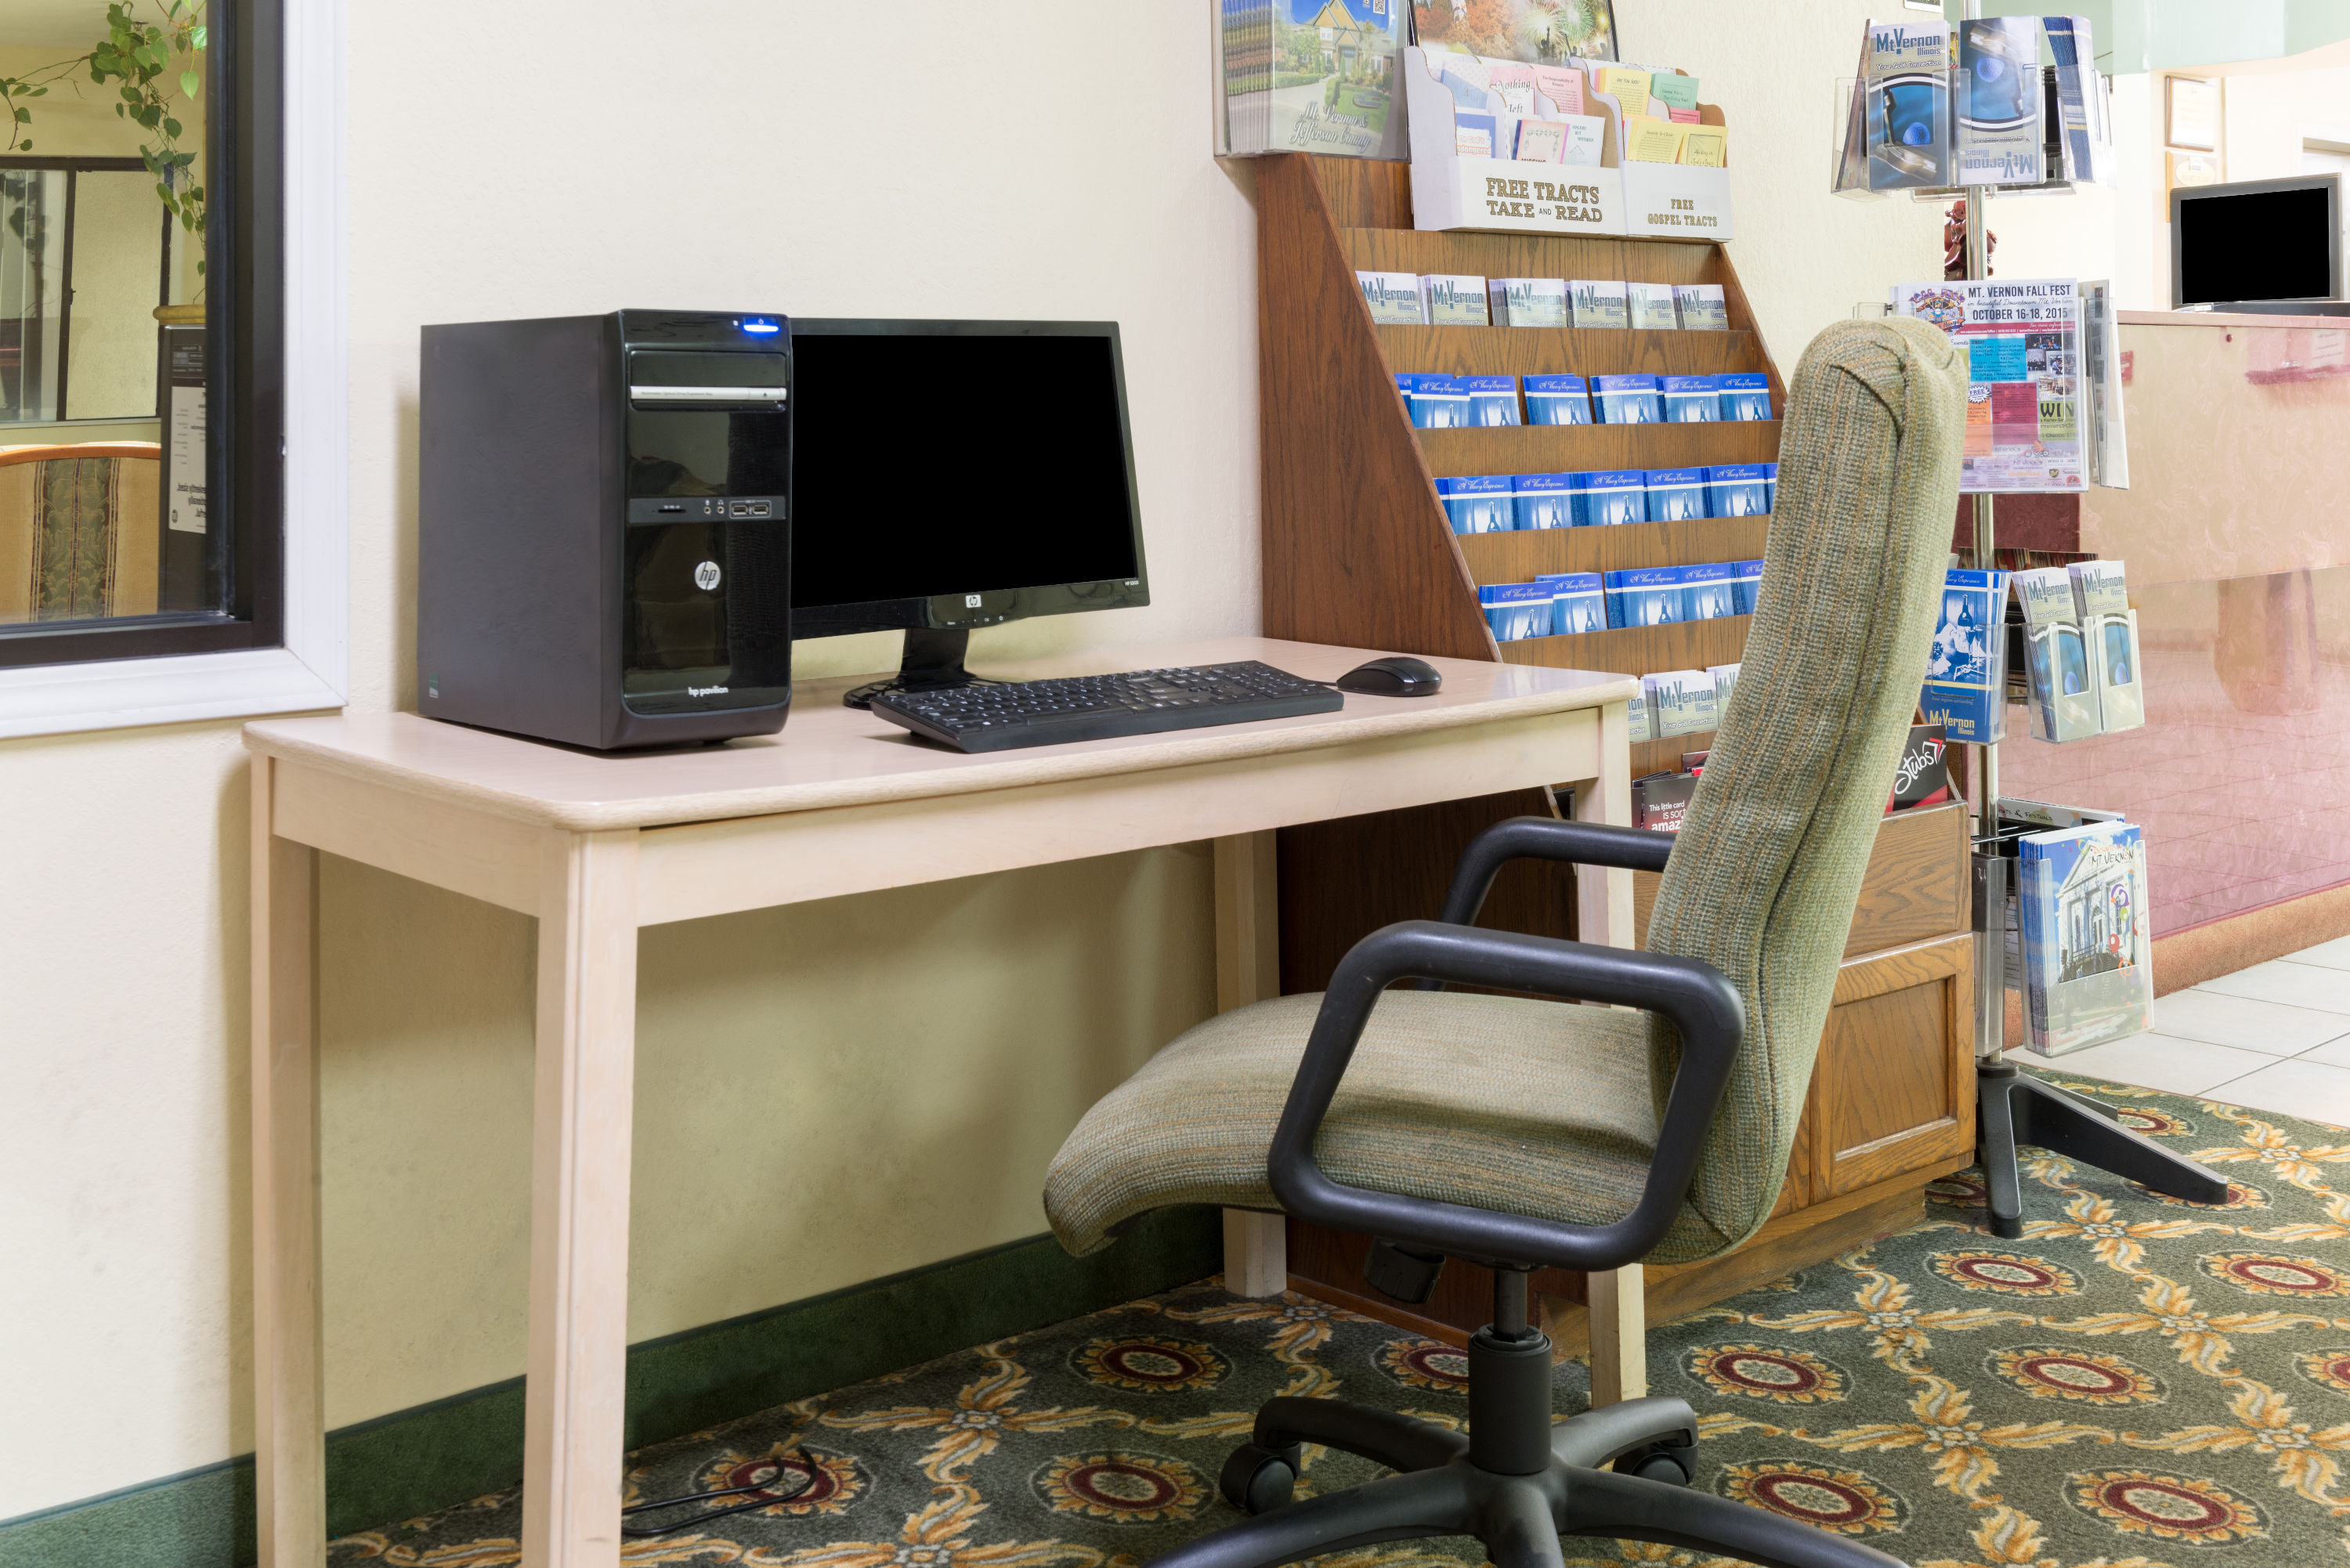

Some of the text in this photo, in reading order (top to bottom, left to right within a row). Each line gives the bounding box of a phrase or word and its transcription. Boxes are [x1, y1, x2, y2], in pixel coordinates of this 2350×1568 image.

[1496, 79, 1531, 92] Nothing
[1299, 100, 1368, 128] Mt. Vernon &
[1289, 120, 1371, 154] Jefferson County
[1486, 177, 1600, 204] FREE TRACTS
[1486, 200, 1535, 218] TAKE
[1555, 205, 1603, 222] READ
[1671, 198, 1694, 211] FREE
[1647, 213, 1718, 227] GOSPEL TRACTS
[1969, 284, 2071, 298] MT. VERNON FALL FEST
[1976, 299, 2001, 309] beautiful
[1972, 307, 2068, 320] OCTOBER 16-18, 2015
[2040, 403, 2074, 417] WIN
[698, 561, 718, 590] hp
[688, 685, 728, 698] hp pavilion
[1894, 748, 1935, 795] Stubs
[1672, 800, 1685, 808] card
[1663, 808, 1687, 820] is sort
[2015, 809, 2053, 822] & FESTIVALS
